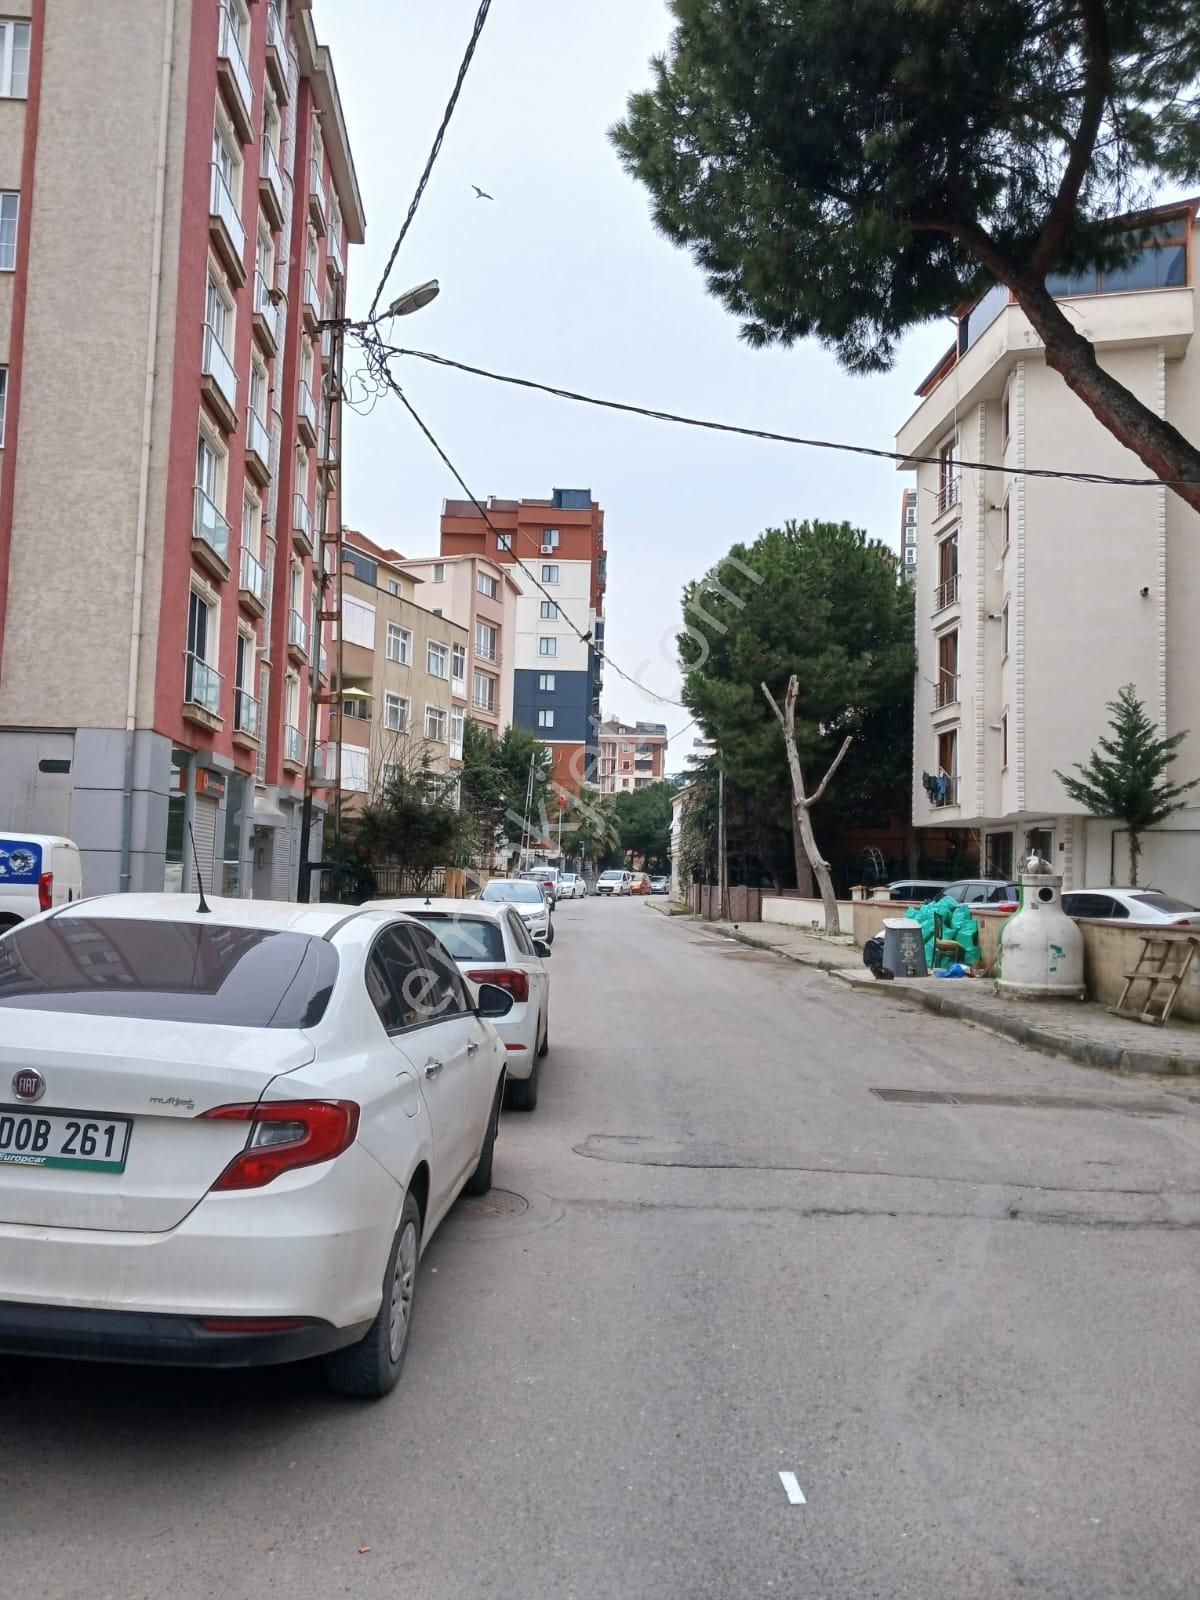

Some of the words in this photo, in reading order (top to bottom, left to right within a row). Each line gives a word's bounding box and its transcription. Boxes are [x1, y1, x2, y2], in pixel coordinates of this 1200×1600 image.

[18, 1078, 38, 1093] FIAT
[0, 1116, 51, 1151] DOB
[60, 1122, 116, 1157] 261
